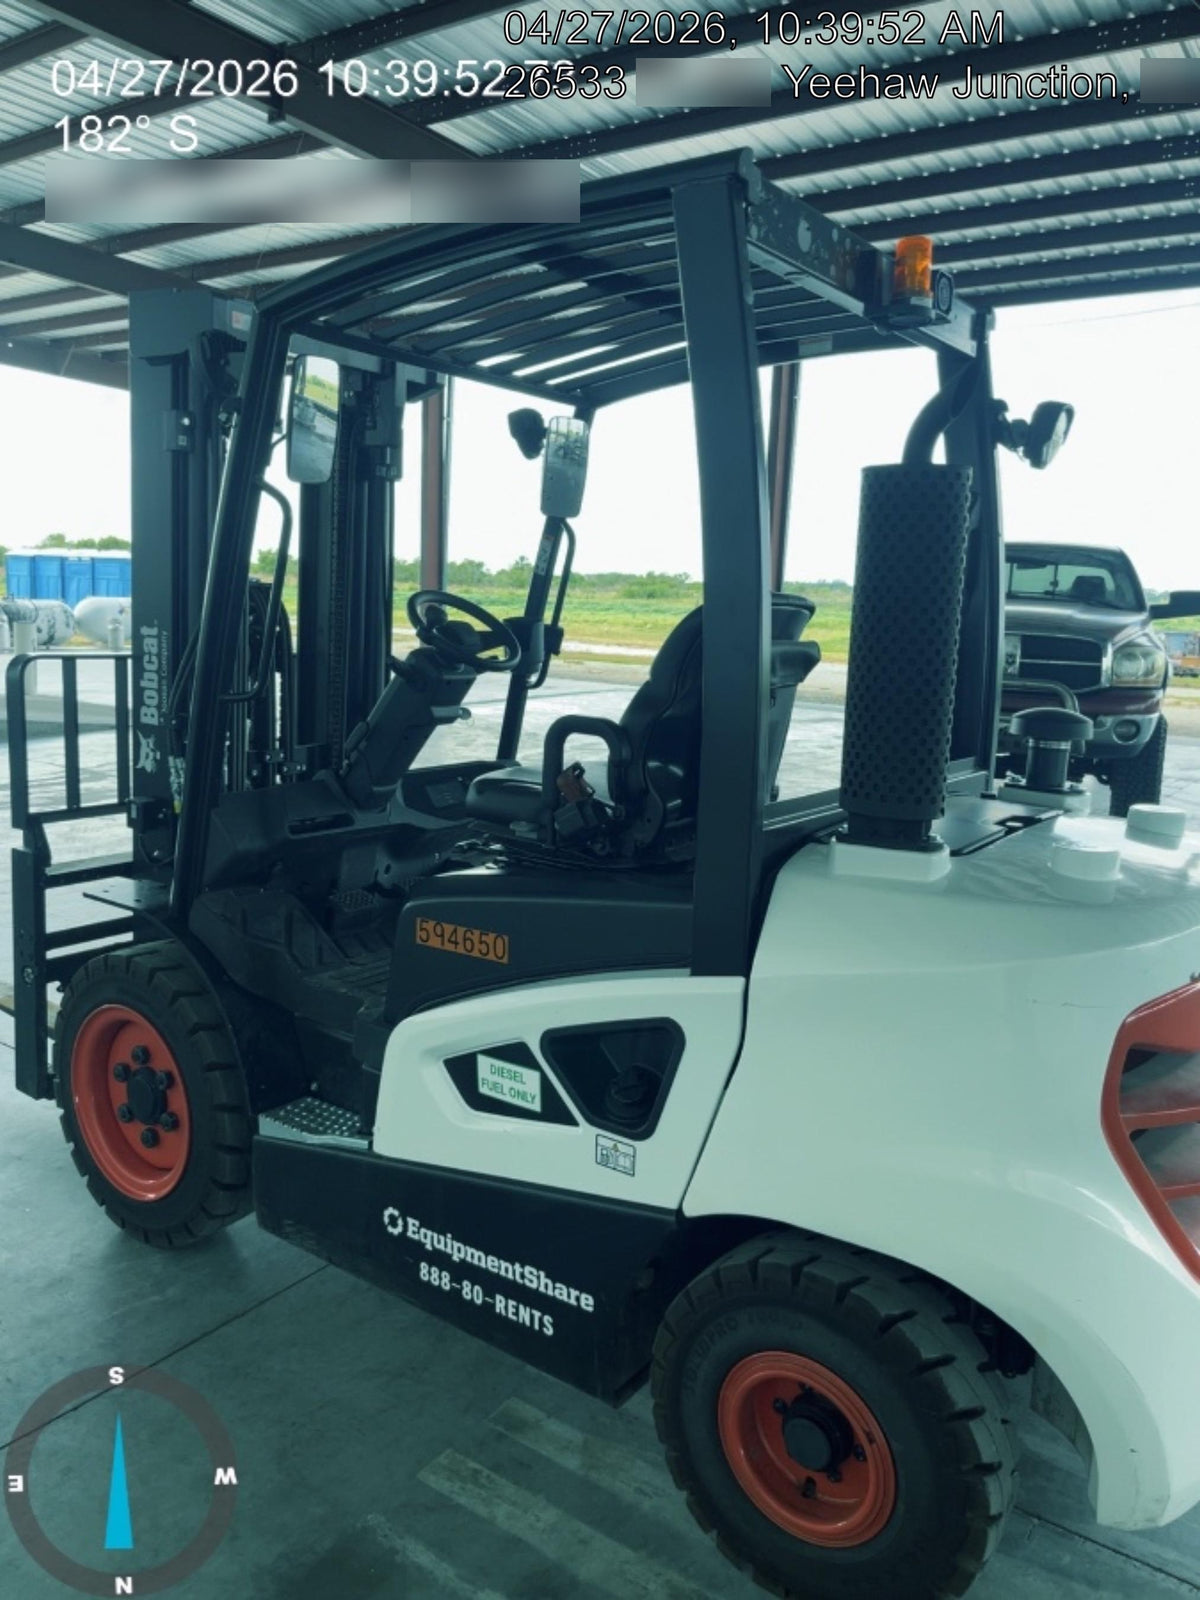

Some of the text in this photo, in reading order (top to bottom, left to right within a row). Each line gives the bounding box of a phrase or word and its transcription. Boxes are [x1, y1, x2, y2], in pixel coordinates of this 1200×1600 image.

[140, 625, 159, 726] Bobcat
[418, 920, 507, 960] 594650
[481, 1077, 537, 1105] FUEL ONLY
[490, 1063, 527, 1085] DIESEL
[406, 1216, 595, 1313] EquipmentShare
[419, 1261, 555, 1337] 888-80-RENTS
